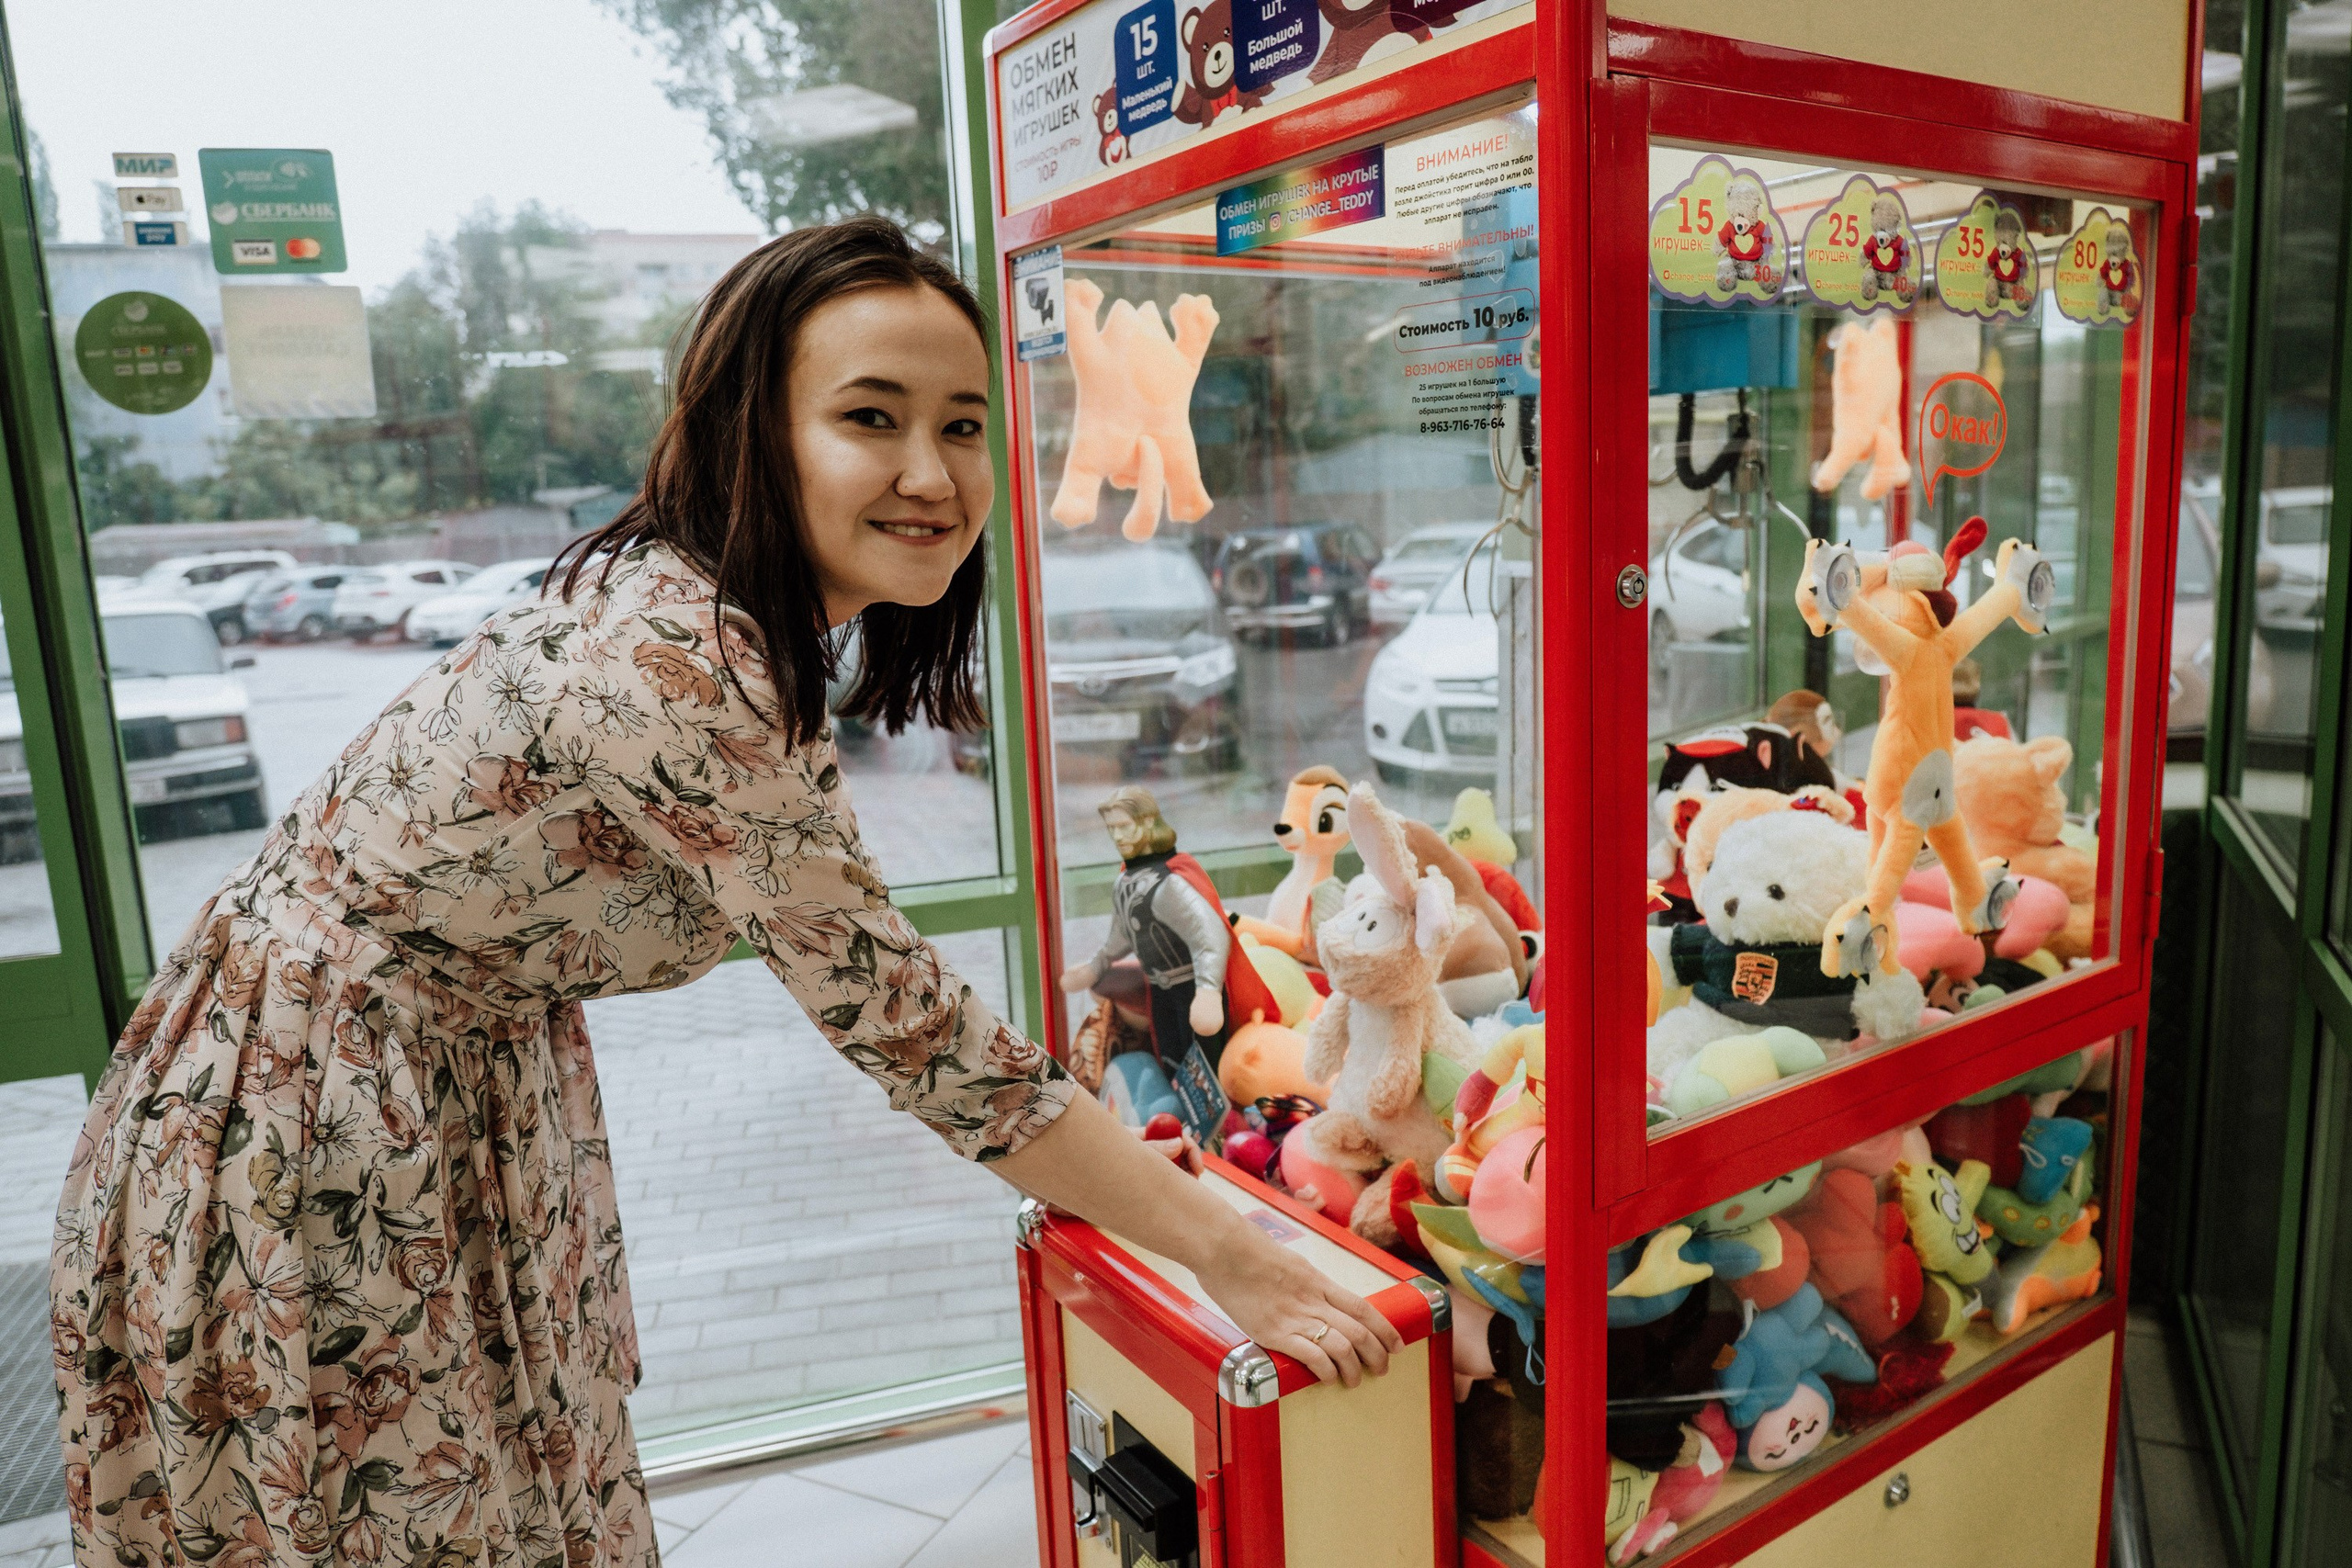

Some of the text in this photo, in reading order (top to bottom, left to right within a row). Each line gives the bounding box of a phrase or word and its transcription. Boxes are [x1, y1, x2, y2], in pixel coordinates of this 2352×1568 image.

[1129, 14, 1159, 62] 15
[1248, 17, 1303, 56] Большой
[1012, 31, 1076, 89] ОБМЕН
[1250, 42, 1303, 73] медведь
[1012, 66, 1079, 119] МЯГКИХ
[1122, 76, 1173, 110] Маленький
[1013, 99, 1080, 147] ИГРУШЕК
[1128, 97, 1168, 122] медведь
[117, 159, 174, 175] МИР
[1417, 134, 1509, 172] ВНИМАНИЕ!
[1395, 153, 1533, 195] Перед оплатой убедитесь, что на табло
[1395, 167, 1534, 208] возле джойстика горит цифра 0 или 00.
[1219, 164, 1379, 221] ОБМЕН ИГРУШЕК НА КРУТЫЕ
[1396, 182, 1532, 220] Любые другие цифры обозначают, что
[241, 202, 336, 219] СБЕРБАНК
[1424, 203, 1499, 226] аппарат не исправен.
[1678, 197, 1713, 235] 15
[1228, 218, 1265, 241] ПРИЗЫ
[1438, 224, 1534, 254] ВНИМАТЕЛЬНЫ!
[1828, 212, 1860, 248] 25
[1957, 226, 1984, 258] 35
[241, 246, 271, 257] VISA
[1654, 236, 1711, 255] игрушек=
[2075, 240, 2097, 269] 80
[1419, 265, 1507, 288] под видеонаблюдением!
[1429, 255, 1496, 274] Аппарат находится
[1399, 306, 1530, 339] Стоимость 10 руб.
[1405, 353, 1522, 378] ВОЗМОЖЕН ОБМЕН
[1412, 388, 1515, 405] По вопросам обмена игрушек
[1419, 383, 1427, 391] 25
[1428, 382, 1457, 393] игрушек
[1468, 378, 1472, 387] 1
[1473, 376, 1507, 389] большую
[1419, 405, 1459, 417] обращаться
[1470, 401, 1507, 413] телефону:
[1930, 402, 1999, 446] Окак!
[1419, 416, 1506, 434] 8-963-716-76-64
